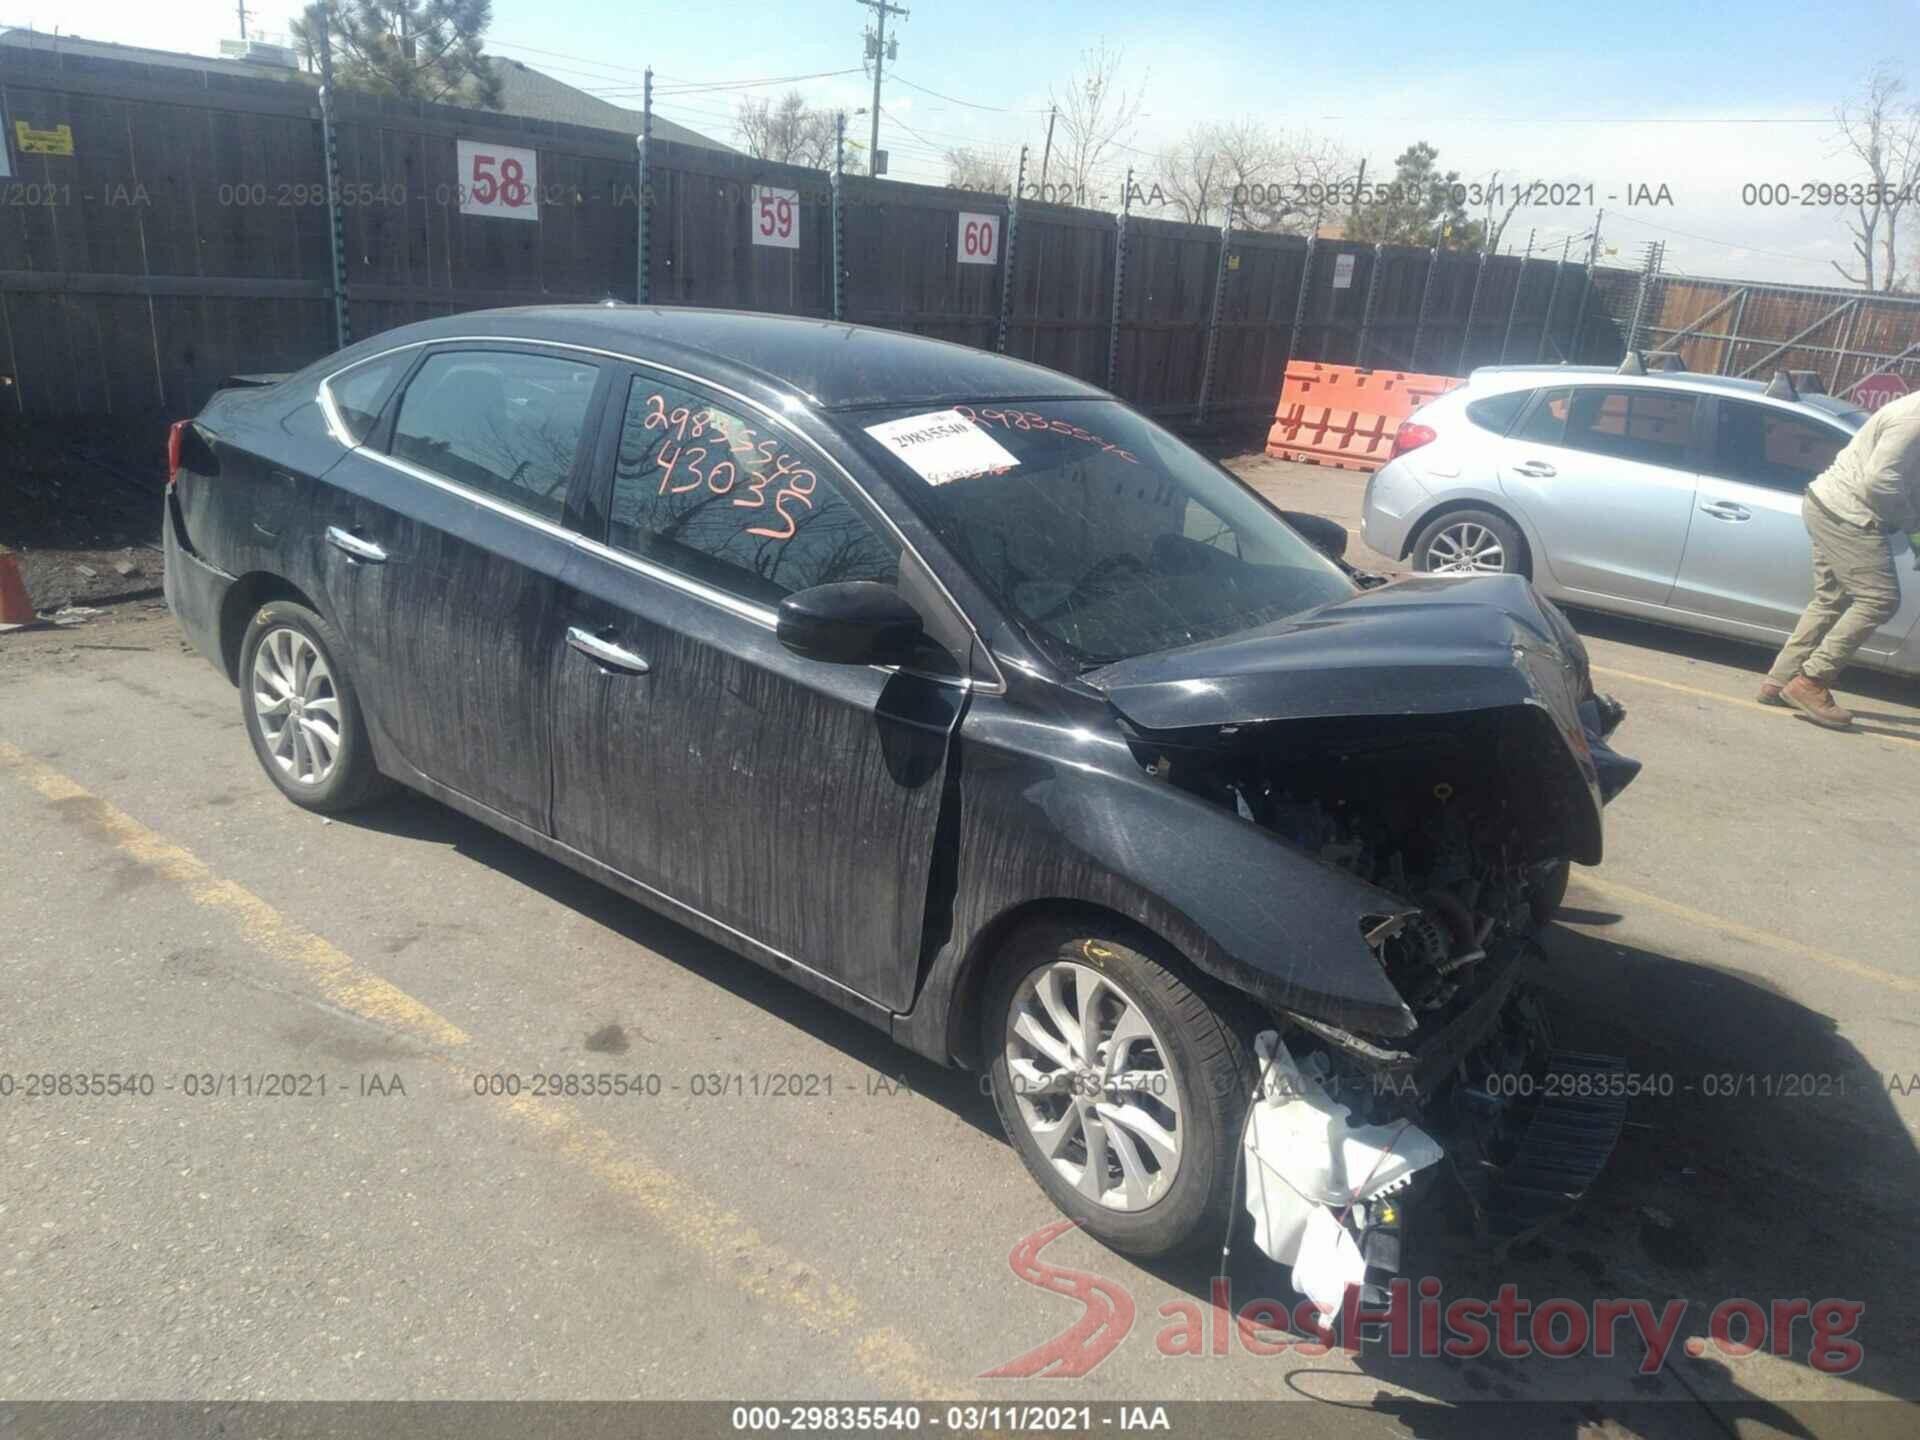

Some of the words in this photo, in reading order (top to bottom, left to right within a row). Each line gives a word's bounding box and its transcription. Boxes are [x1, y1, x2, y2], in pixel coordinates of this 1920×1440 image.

[472, 155, 526, 207] 58
[760, 197, 792, 238] 59
[964, 222, 993, 256] 60
